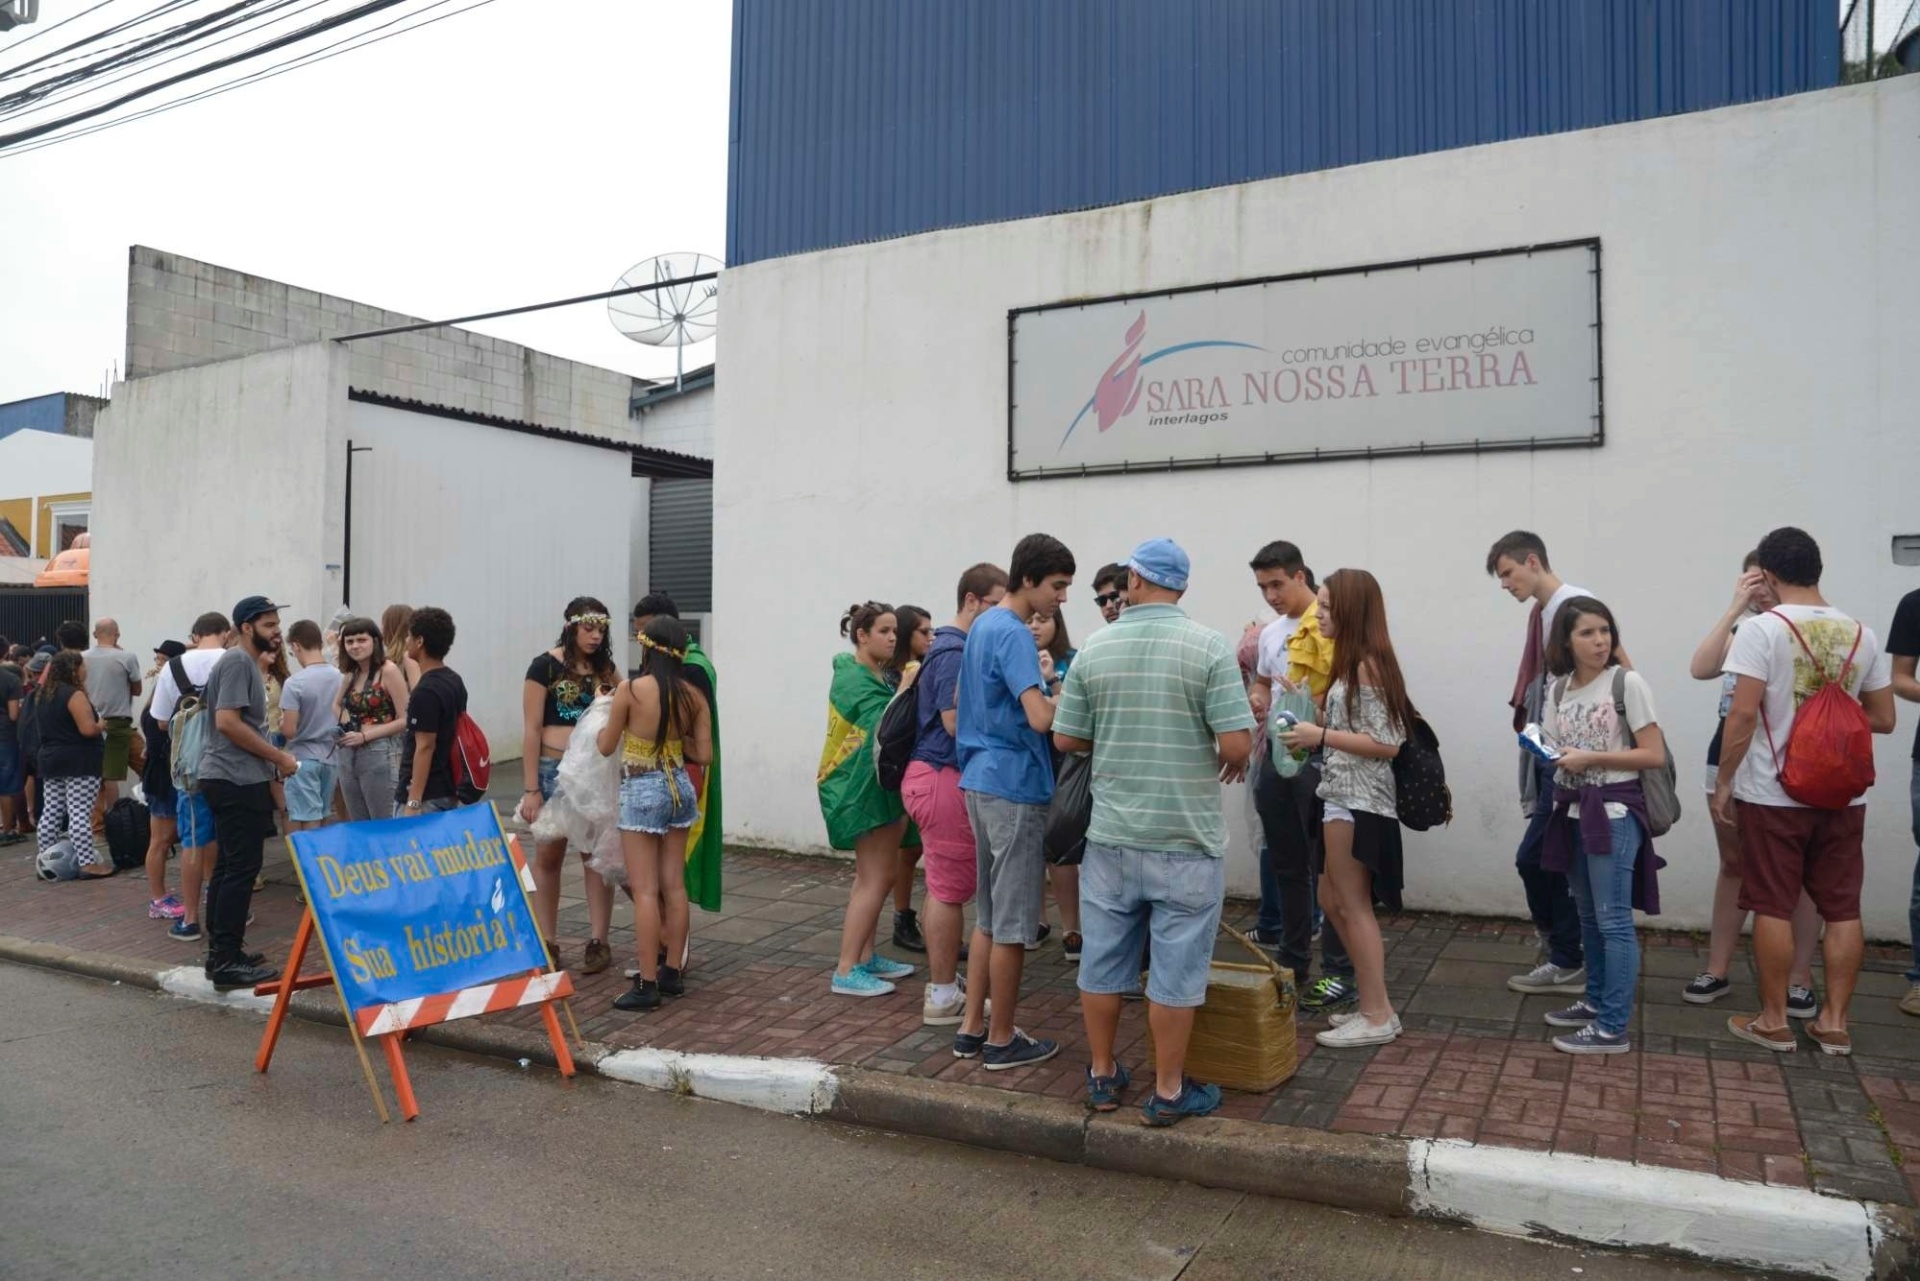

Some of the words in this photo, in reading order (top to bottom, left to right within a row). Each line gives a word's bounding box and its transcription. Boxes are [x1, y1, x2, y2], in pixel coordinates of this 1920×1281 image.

[1281, 337, 1406, 365] comunidade
[1415, 326, 1534, 354] evangélica
[1147, 376, 1231, 413] SARA
[1242, 363, 1379, 406] NOSSA
[1390, 350, 1538, 395] TERRA
[1148, 411, 1229, 426] interlagos
[316, 855, 390, 899] Deus
[389, 839, 433, 884] vai
[431, 829, 507, 877] mudar
[343, 937, 397, 984] Sua
